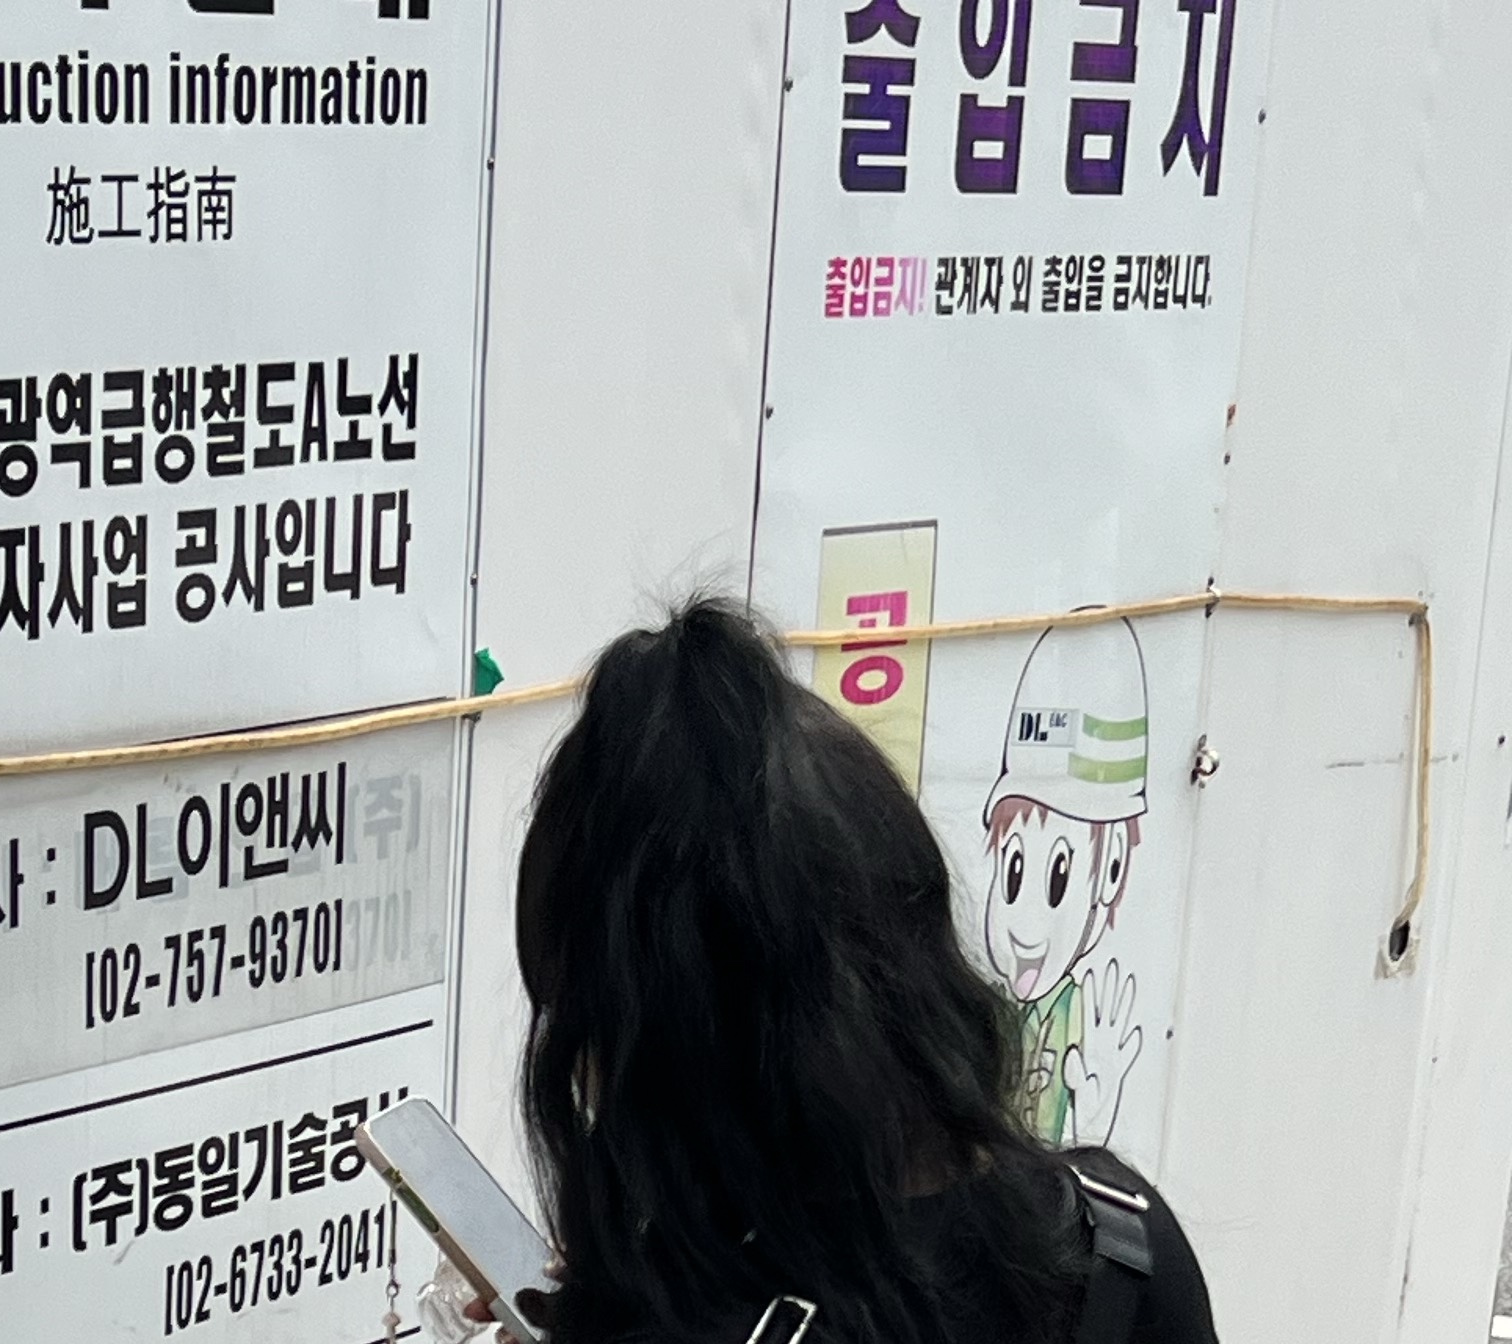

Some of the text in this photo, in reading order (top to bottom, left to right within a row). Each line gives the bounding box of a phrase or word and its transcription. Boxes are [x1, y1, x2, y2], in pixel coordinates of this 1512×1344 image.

[169, 51, 428, 126] information
[838, 0, 1237, 197] 출입금지
[45, 165, 237, 246] 施工指南
[934, 255, 1004, 316] 관계자
[1009, 255, 1034, 314] 외
[1040, 254, 1106, 314] 출입을
[1112, 253, 1213, 312] 금지합니다.
[174, 489, 413, 624] 공사입니다
[83, 761, 348, 912] DL이앤씨
[85, 898, 343, 1030] [02-757-9370]
[72, 1086, 410, 1253] (주)동일기술공
